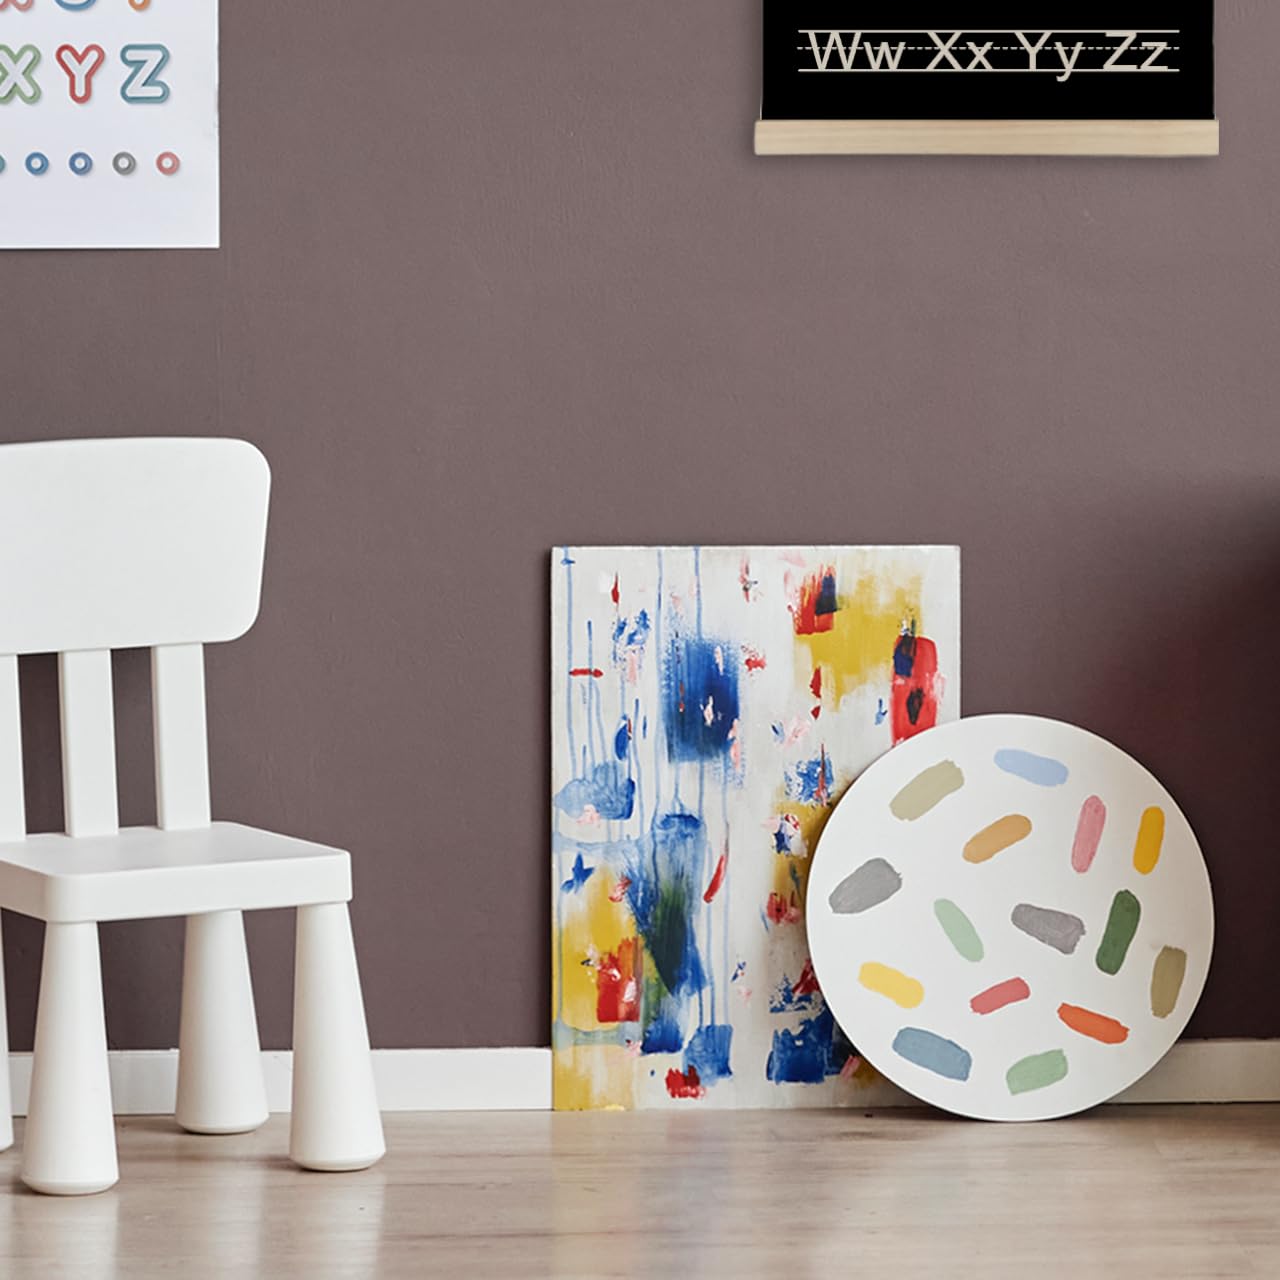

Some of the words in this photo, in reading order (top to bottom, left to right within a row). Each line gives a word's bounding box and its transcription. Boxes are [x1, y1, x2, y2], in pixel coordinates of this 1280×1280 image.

[808, 31, 906, 71] Ww
[926, 31, 994, 71] Xx
[1015, 31, 1084, 81] Yy
[1102, 31, 1169, 71] Zz
